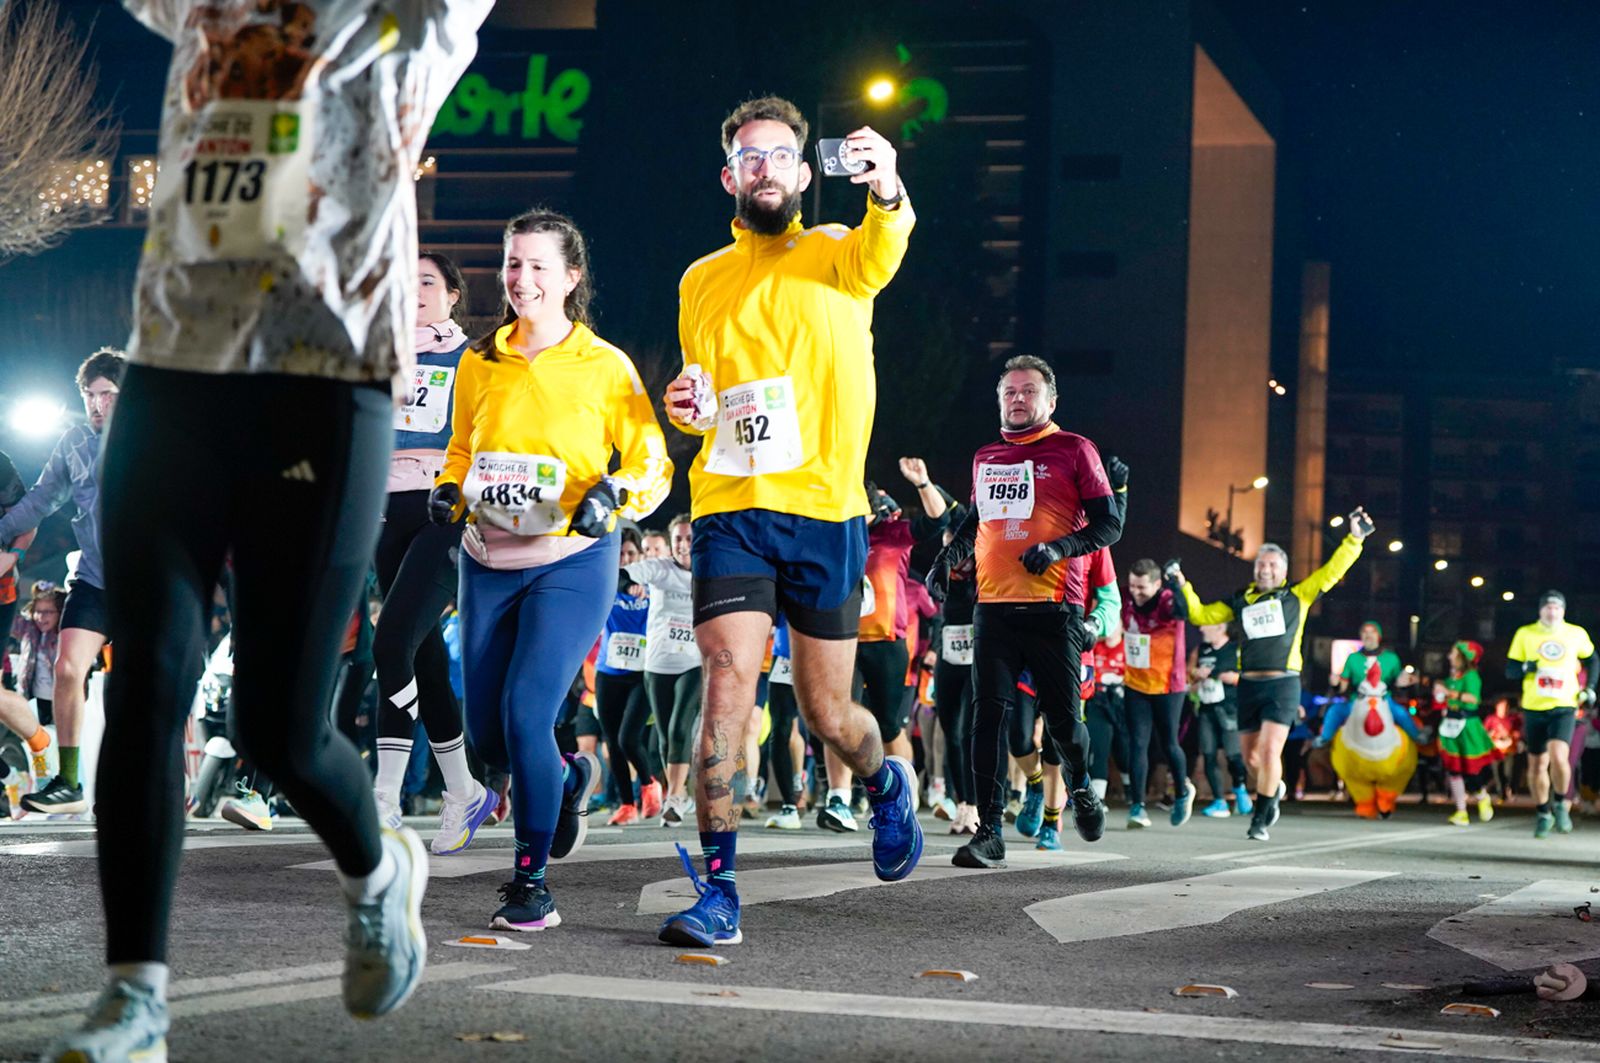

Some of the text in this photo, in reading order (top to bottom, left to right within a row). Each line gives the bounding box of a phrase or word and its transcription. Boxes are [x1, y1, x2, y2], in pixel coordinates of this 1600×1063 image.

[185, 160, 267, 204] 1173
[735, 415, 771, 446] 452
[487, 463, 528, 473] NOCHE DE
[481, 483, 543, 506] 4834
[988, 482, 1029, 500] 1958
[616, 645, 640, 658] 3471
